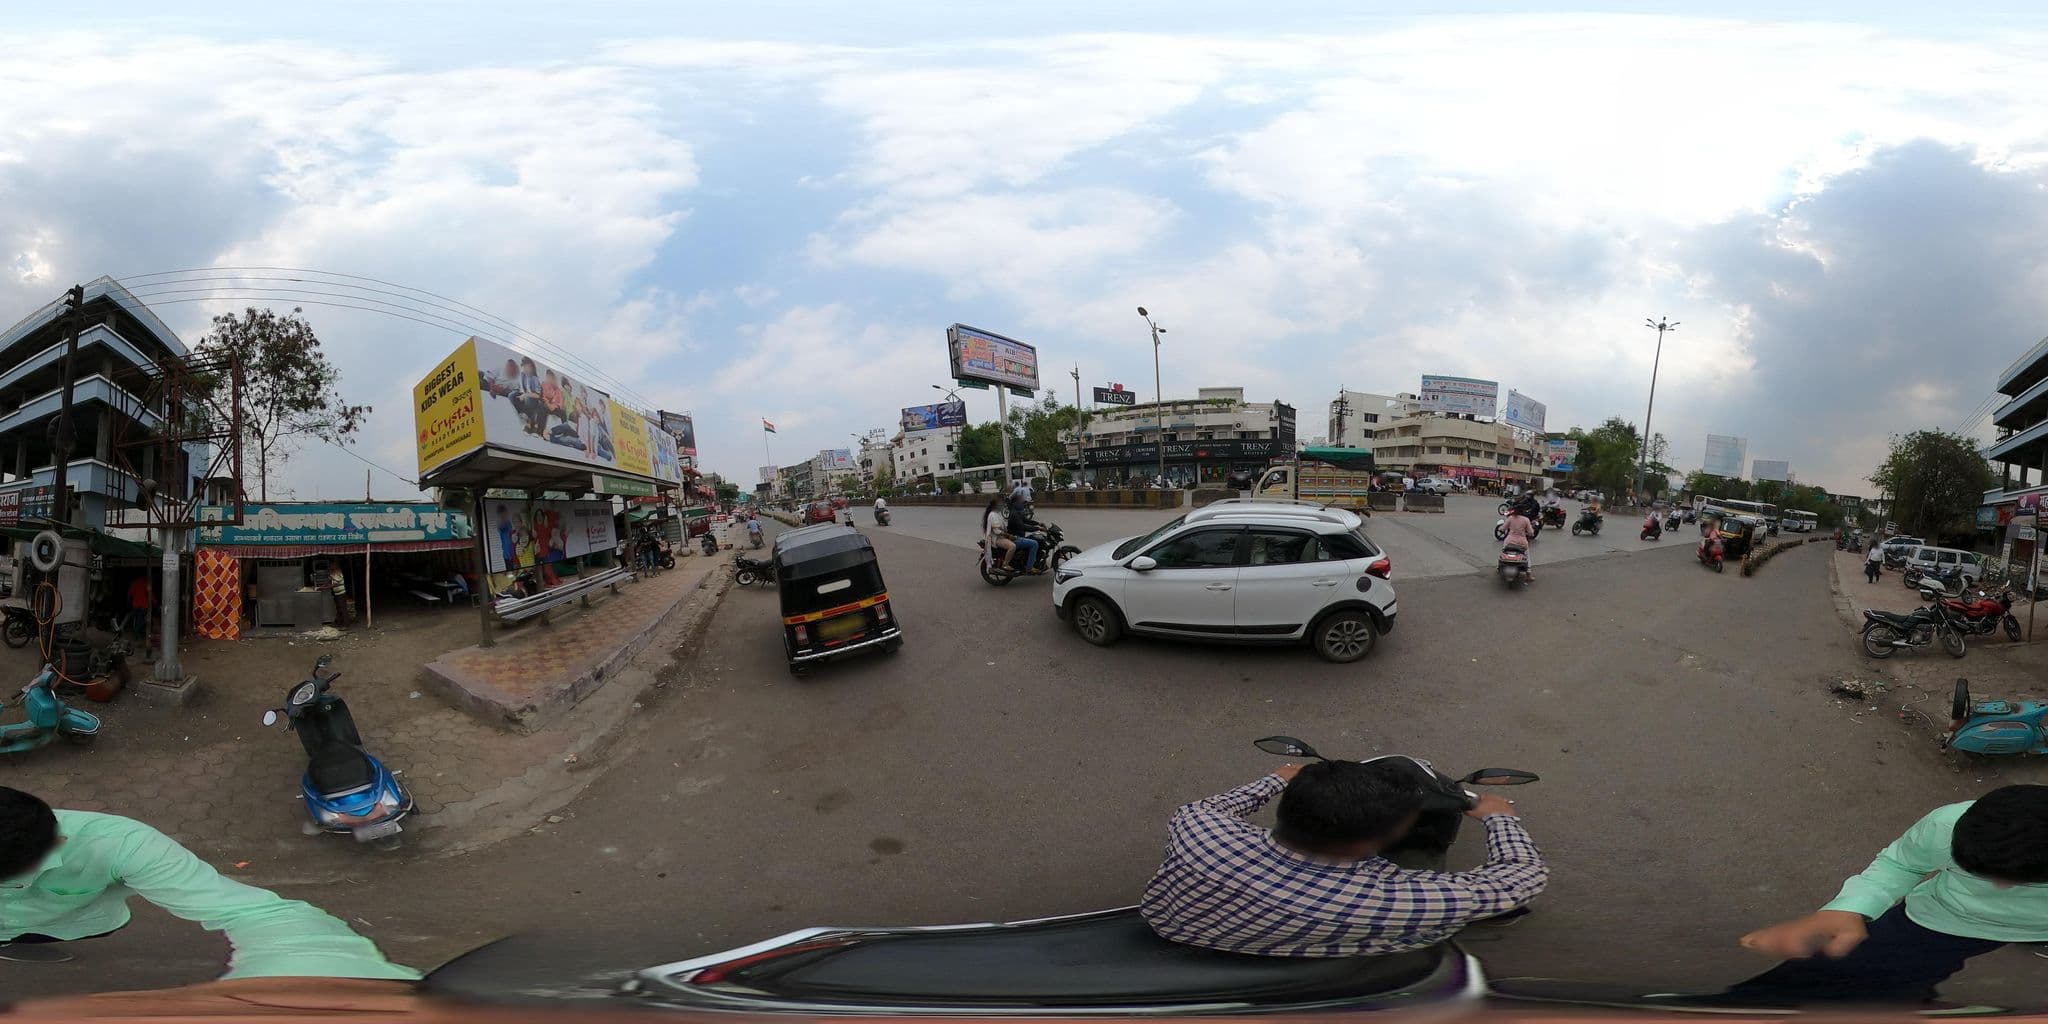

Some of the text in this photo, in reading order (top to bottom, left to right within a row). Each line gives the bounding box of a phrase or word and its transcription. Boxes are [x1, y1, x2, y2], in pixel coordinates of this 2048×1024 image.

[424, 361, 456, 396] BIGGEST
[421, 371, 464, 413] KIDS WEAR
[1101, 392, 1132, 404] TRENZ
[430, 396, 474, 436] Crystal
[432, 416, 475, 446] READYMADES
[1094, 449, 1120, 458] TRENZ
[1161, 444, 1192, 453] TRENZ
[1240, 442, 1273, 451] TRENZ
